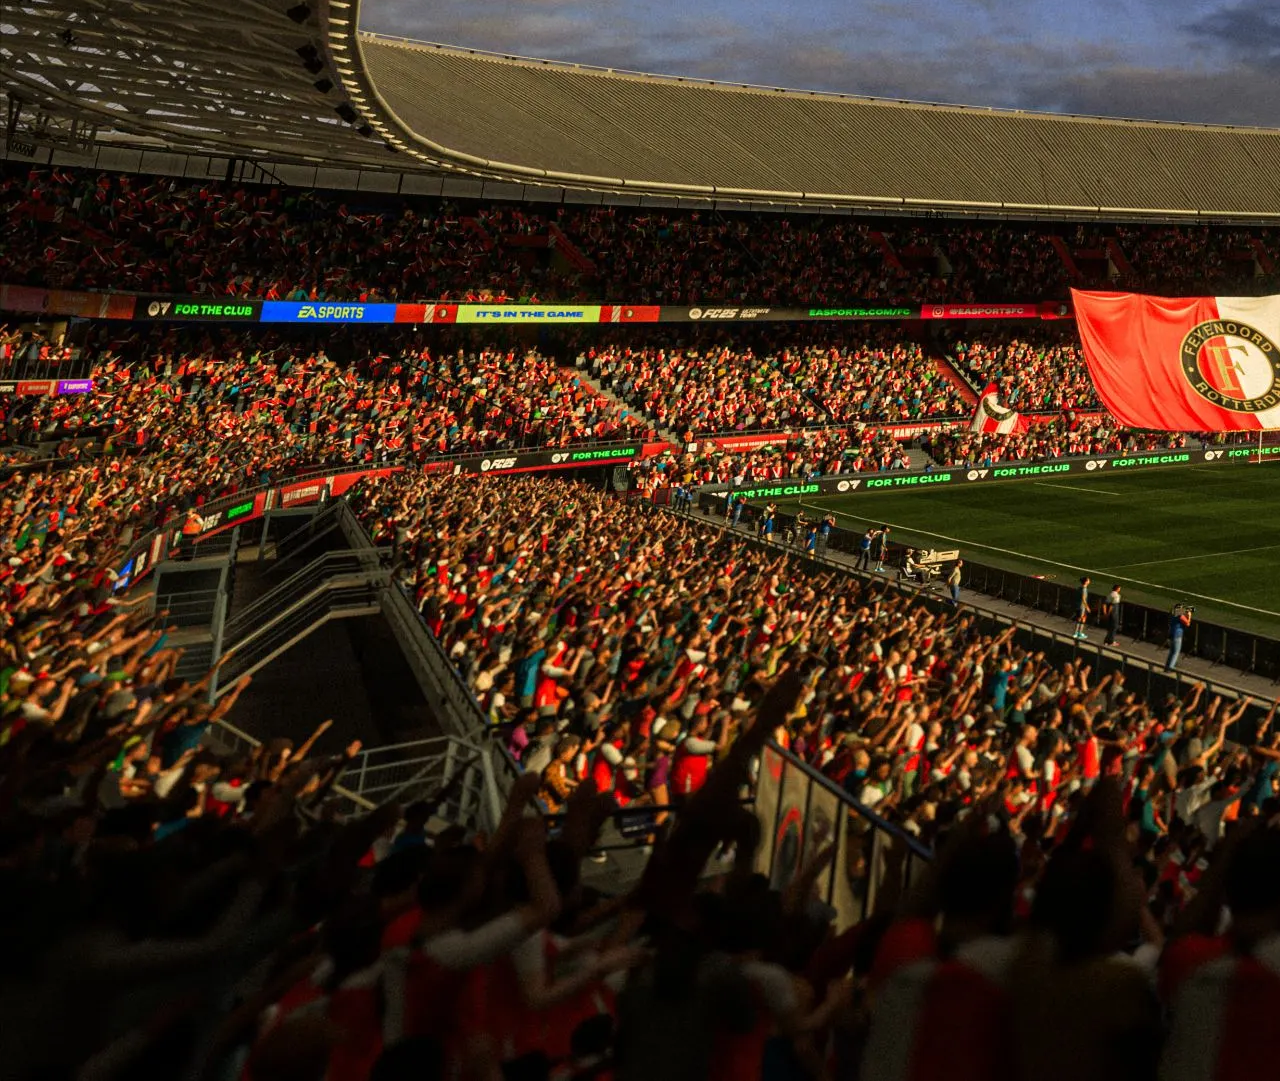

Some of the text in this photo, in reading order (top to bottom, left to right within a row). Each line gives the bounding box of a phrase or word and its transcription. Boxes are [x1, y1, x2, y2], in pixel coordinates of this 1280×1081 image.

[174, 304, 253, 316] FOR THE CLUB
[297, 306, 365, 319] EA SPORTS
[702, 308, 740, 318] FC25
[808, 308, 912, 317] EASPORTS.COM/FC
[950, 307, 1024, 316] @EASPORTSFC
[1184, 323, 1273, 356] FEYENOORD
[572, 449, 634, 460] FOR THE CLUB
[1228, 449, 1249, 457] FOR
[1251, 448, 1271, 456] THE
[1112, 454, 1190, 466] FOR THE CLUB
[994, 464, 1070, 477] FOR THE CLUB
[867, 474, 951, 488] FOR THE CLUB
[732, 485, 818, 500] FOR THE CLUB
